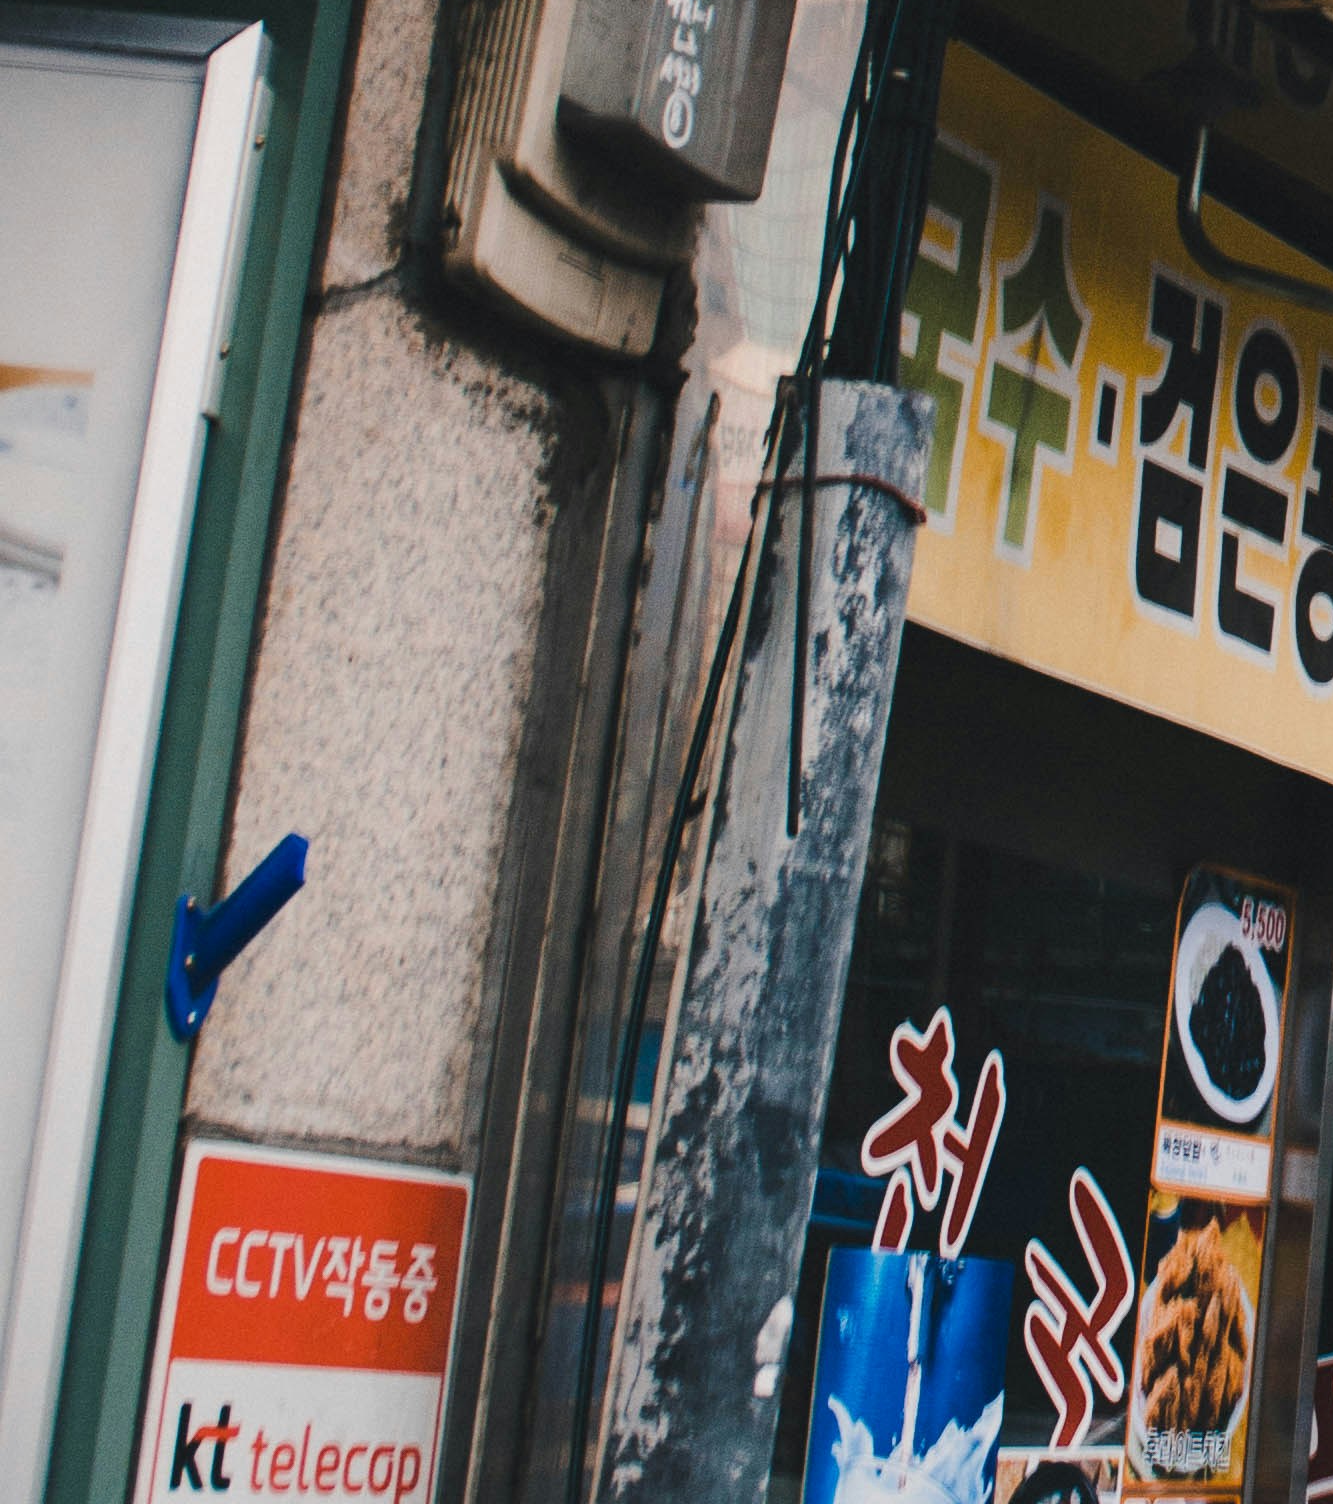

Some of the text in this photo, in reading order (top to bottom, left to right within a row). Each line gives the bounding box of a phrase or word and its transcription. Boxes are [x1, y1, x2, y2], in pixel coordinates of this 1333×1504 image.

[1240, 894, 1287, 952] 5,500
[204, 1225, 438, 1324] CCTV작동중
[168, 1400, 241, 1493] kt
